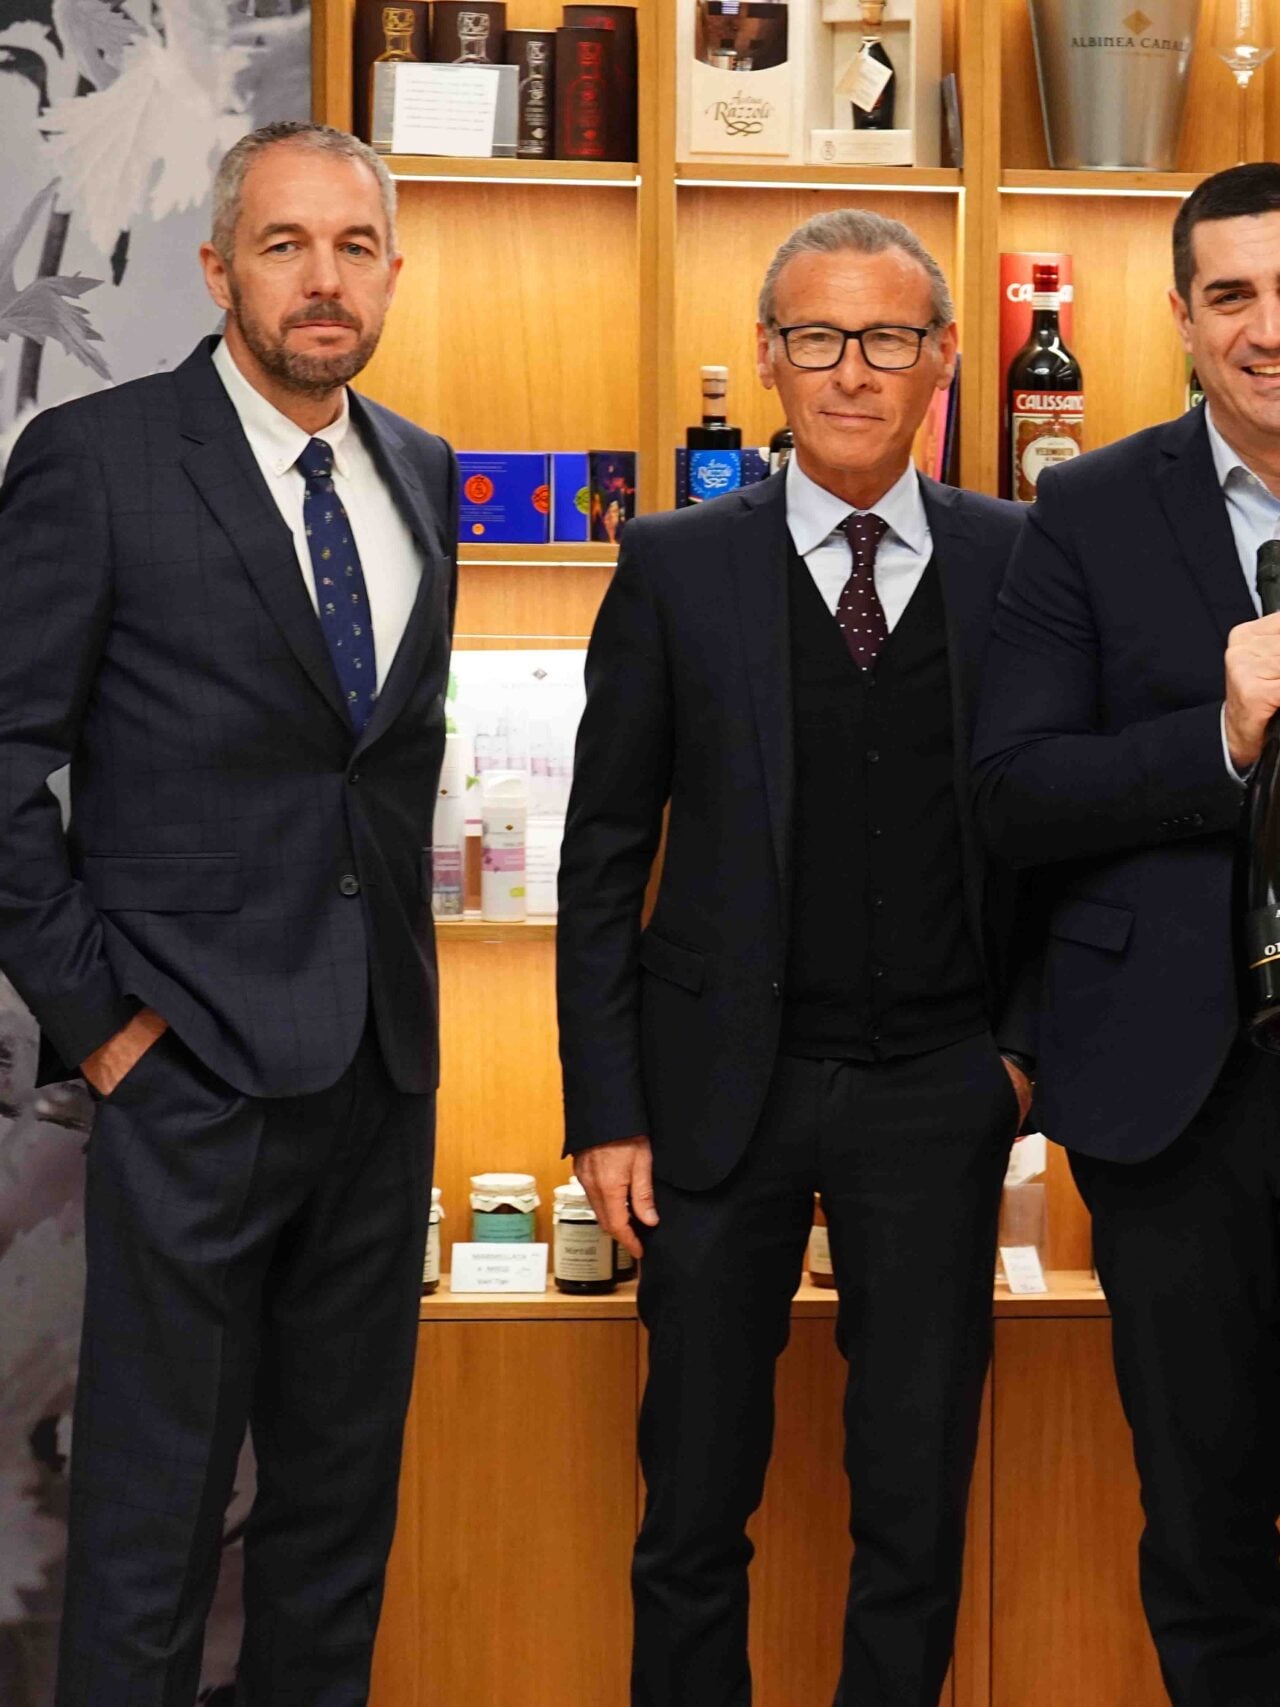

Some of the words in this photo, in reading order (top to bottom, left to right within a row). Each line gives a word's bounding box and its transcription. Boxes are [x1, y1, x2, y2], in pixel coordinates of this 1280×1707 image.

[1071, 36, 1136, 48] ALBINEA
[1140, 37, 1189, 52] CANAL
[1016, 393, 1084, 411] CALISSAN
